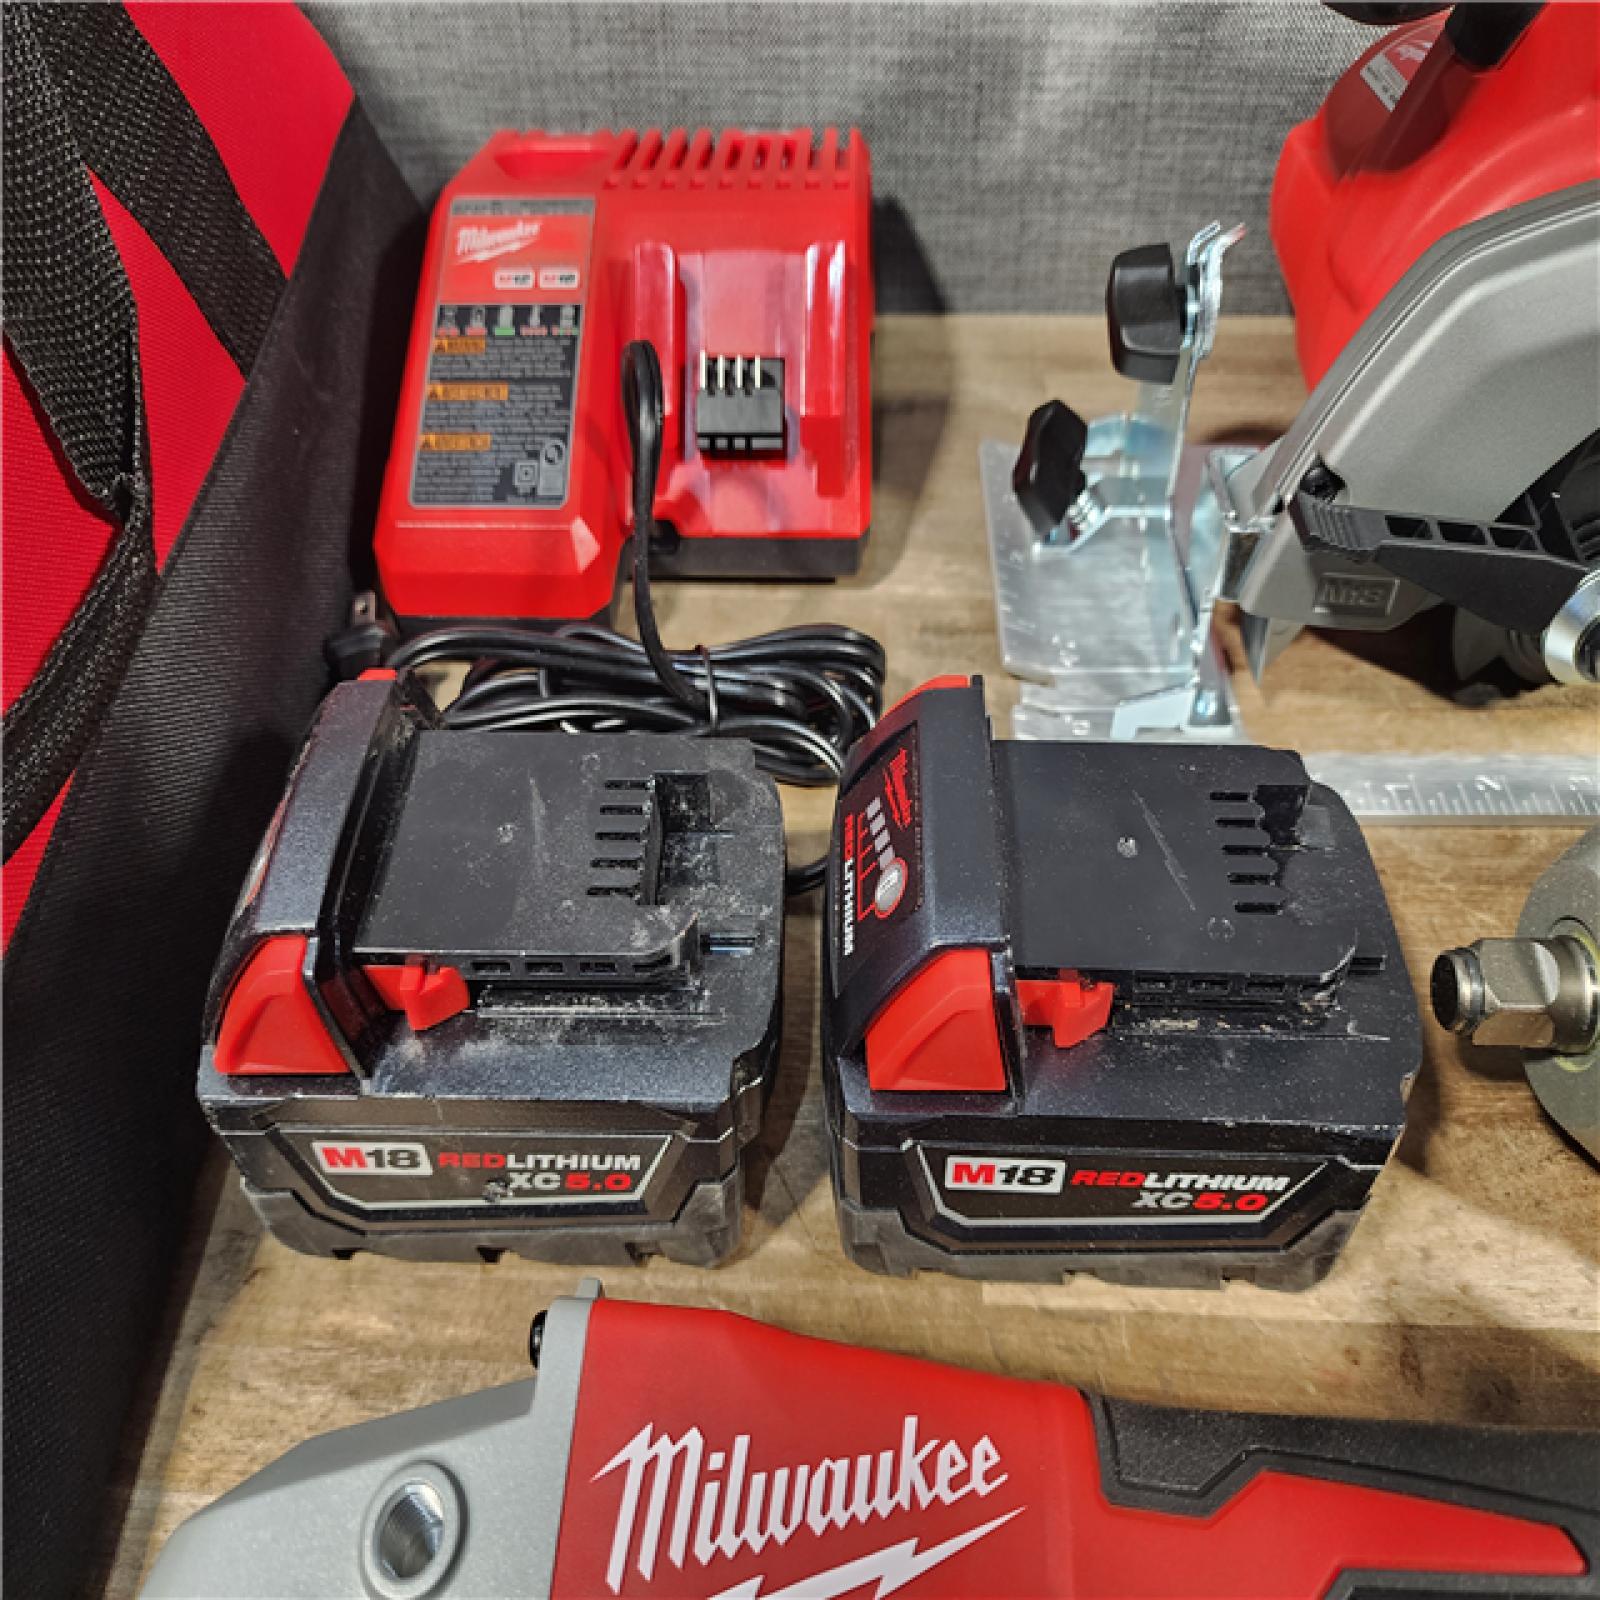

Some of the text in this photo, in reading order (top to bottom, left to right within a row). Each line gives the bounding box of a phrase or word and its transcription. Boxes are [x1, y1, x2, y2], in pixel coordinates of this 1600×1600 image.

[322, 1146, 422, 1169] M18
[437, 1151, 641, 1171] REDLITHIUM
[952, 1162, 1057, 1185] M18
[1070, 1169, 1291, 1191] REDLITHIUM
[589, 1414, 1008, 1596] Milwaukee
